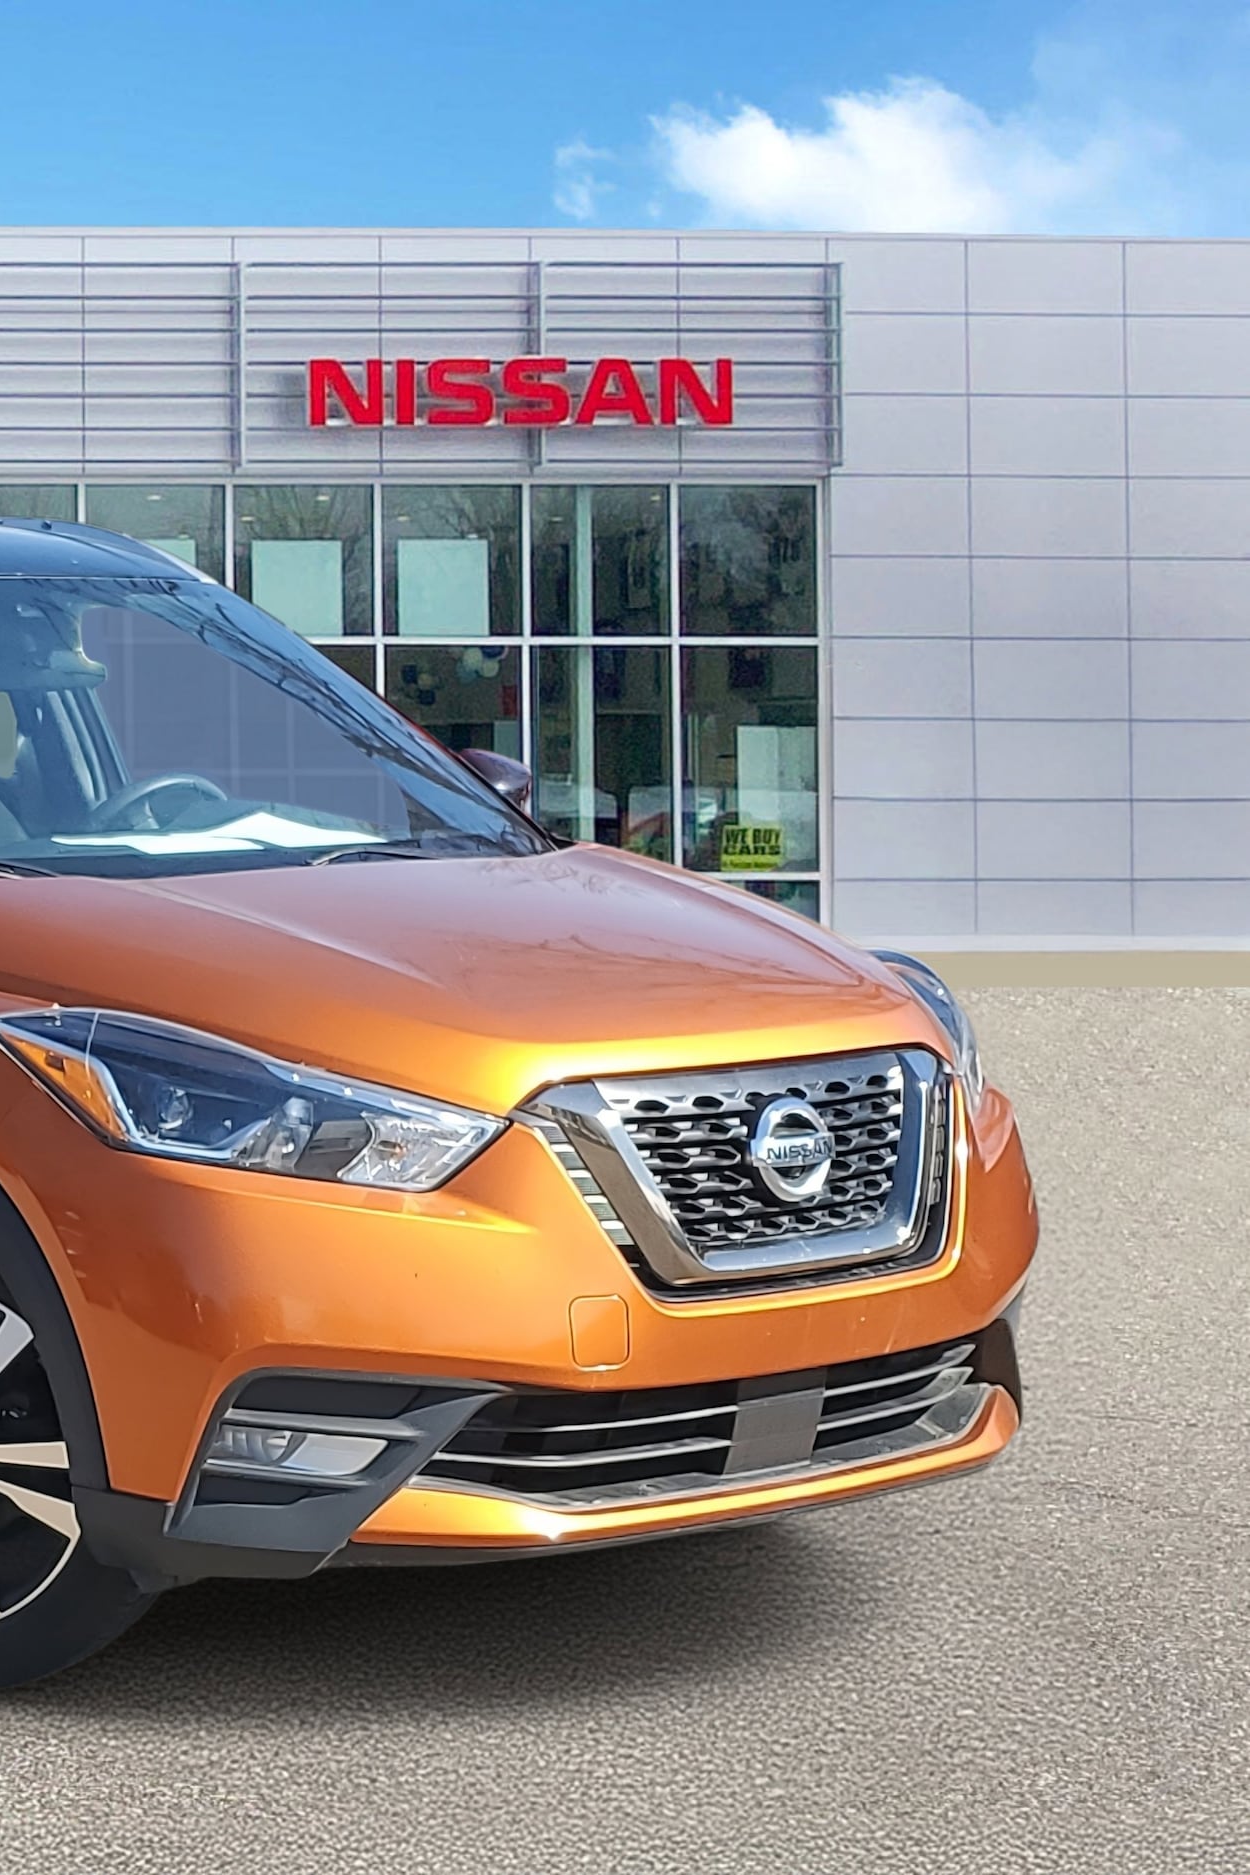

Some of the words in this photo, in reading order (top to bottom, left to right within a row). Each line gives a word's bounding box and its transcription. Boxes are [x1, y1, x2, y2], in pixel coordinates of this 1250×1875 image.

[308, 358, 734, 426] NISSAN
[725, 828, 748, 844] WE
[753, 828, 781, 844] BUY
[723, 845, 781, 855] CARS
[766, 1139, 832, 1160] NISSAN
